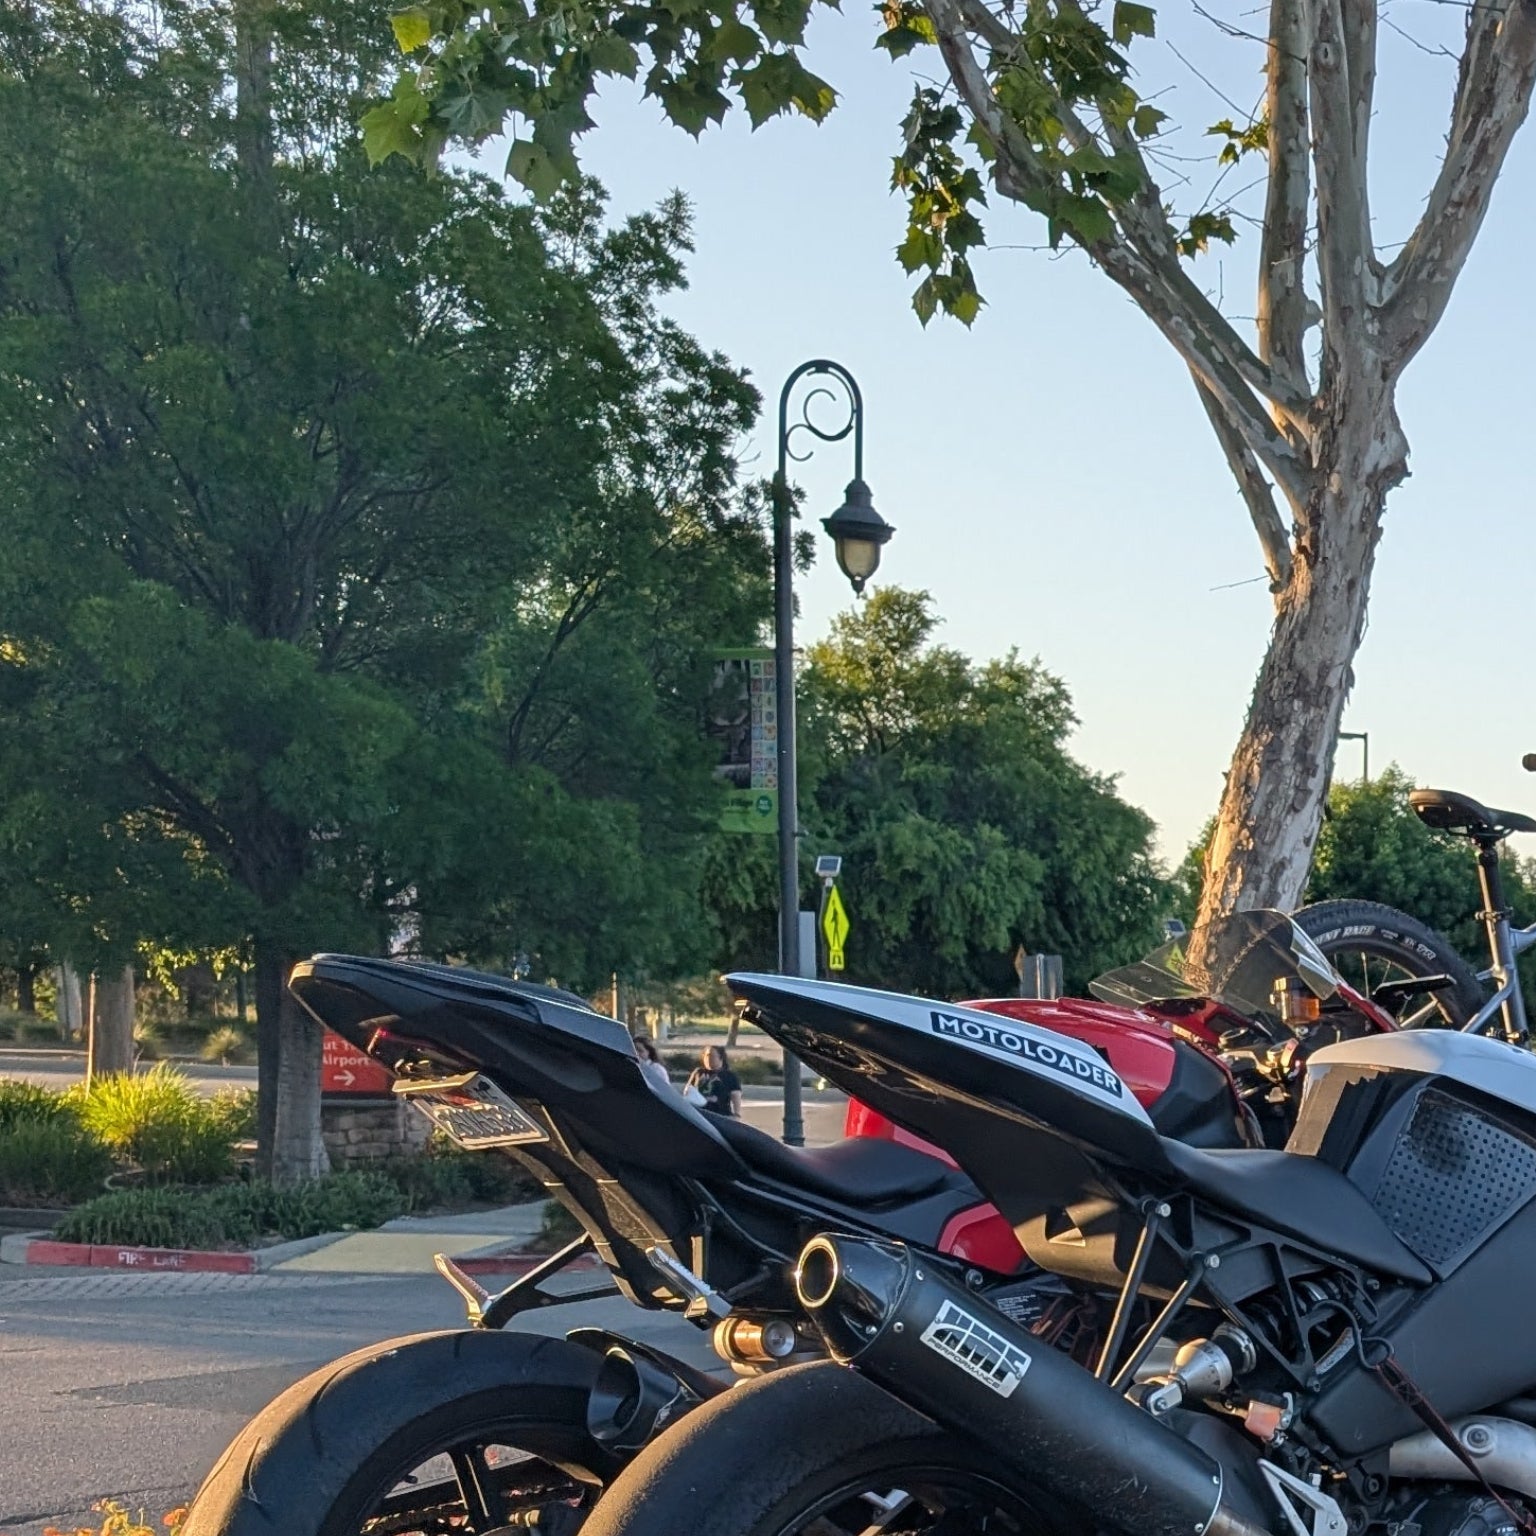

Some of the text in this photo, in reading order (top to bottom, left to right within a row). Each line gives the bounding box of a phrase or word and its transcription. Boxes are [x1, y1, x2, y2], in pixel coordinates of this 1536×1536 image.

[322, 1055, 371, 1068] Airport
[937, 1014, 1118, 1093] MOTOLOADER
[927, 1337, 1001, 1390] PERFORMANCE
